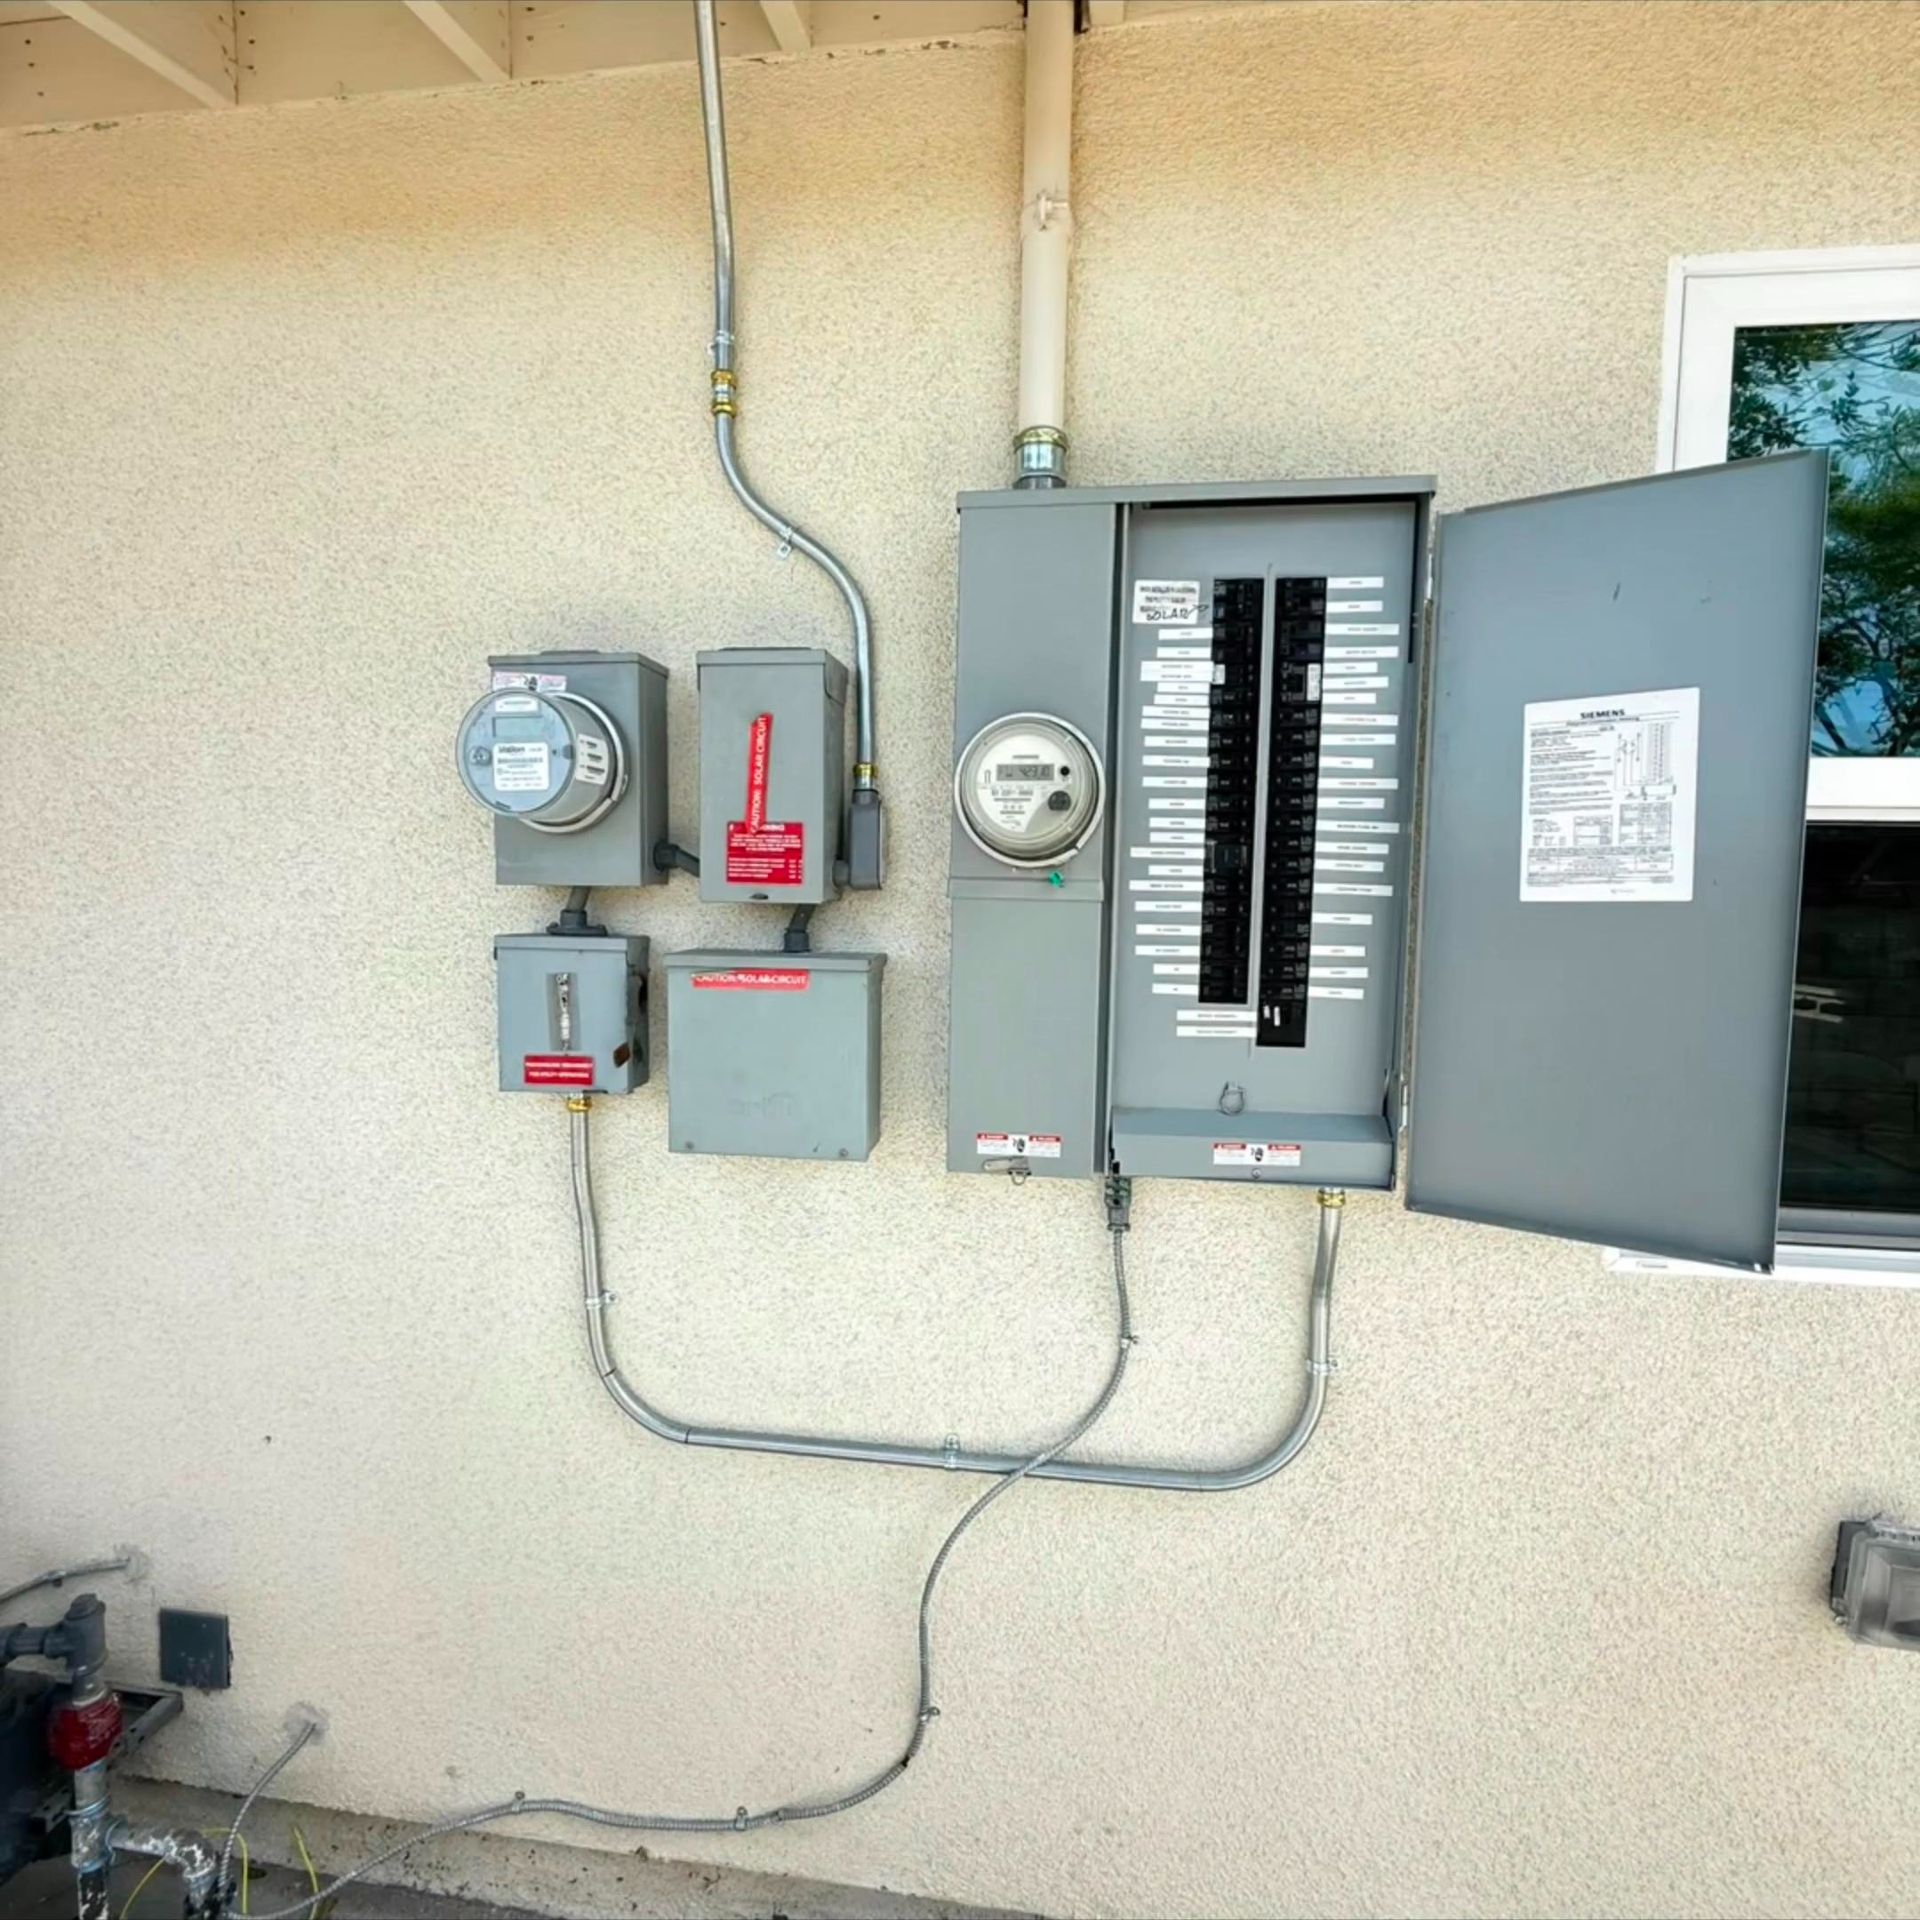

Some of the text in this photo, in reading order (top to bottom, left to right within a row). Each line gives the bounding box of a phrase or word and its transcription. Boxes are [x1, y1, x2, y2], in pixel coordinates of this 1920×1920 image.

[1580, 709, 1625, 719] SIEMENS
[756, 716, 767, 753] CIRCUIT
[753, 754, 764, 786] SOLAR
[771, 975, 806, 985] CIRCUIT
